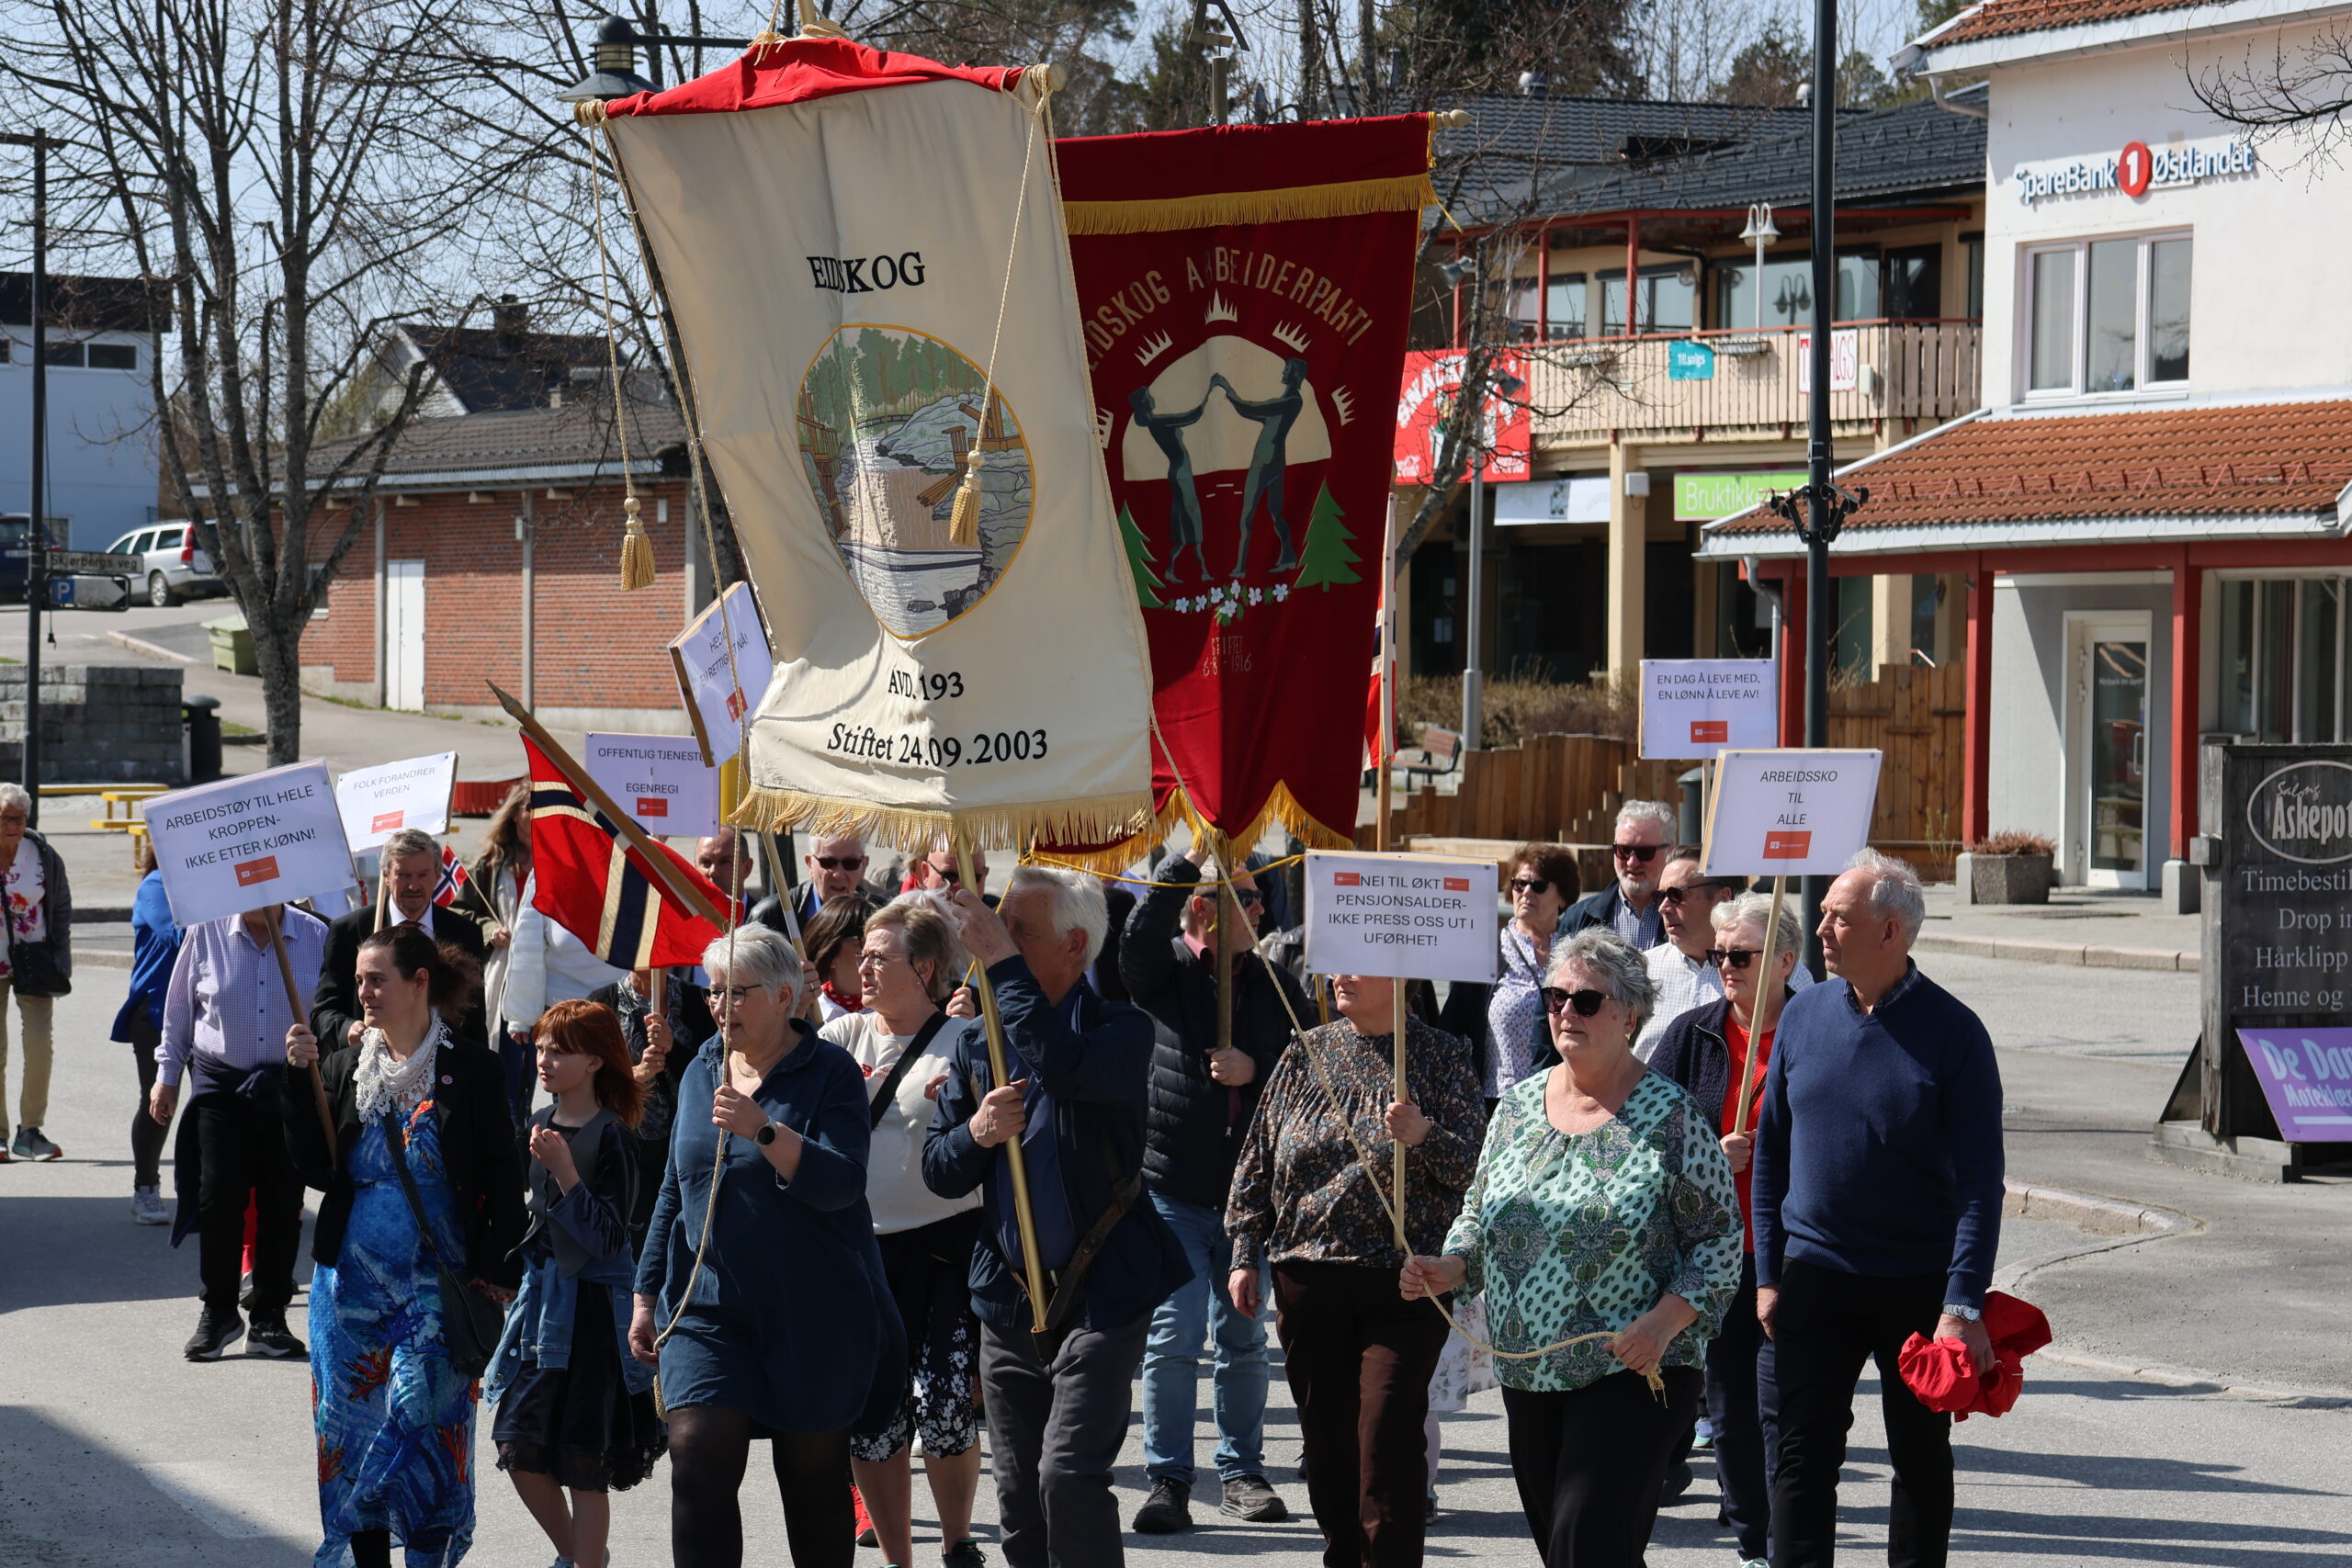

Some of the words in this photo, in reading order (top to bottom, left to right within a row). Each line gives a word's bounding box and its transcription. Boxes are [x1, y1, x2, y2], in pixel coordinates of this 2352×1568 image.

[2014, 158, 2118, 204] SpareBank
[2126, 151, 2139, 187] 1
[2152, 142, 2254, 183] Østlandet
[806, 252, 925, 294] EIDSKOG
[1087, 270, 1171, 371] IDSKOG
[57, 581, 70, 601] P
[920, 671, 965, 701] 193
[1657, 674, 1671, 684] EN
[1674, 674, 1696, 684] DAG
[1698, 671, 1705, 684] Å
[1707, 673, 1732, 684] LEVE
[1734, 673, 1760, 684] MED,
[1658, 690, 1672, 700] EN
[1675, 690, 1705, 700] LØNN
[1707, 687, 1714, 699] Å
[1716, 690, 1741, 699] LEVE
[1743, 689, 1759, 699] AV!
[598, 748, 655, 760] OFFENTLIG
[827, 722, 893, 761] Stiftet
[899, 728, 1048, 768] 24.09.2003
[354, 778, 378, 791] FOLK
[379, 766, 435, 785] FORANDRER
[1759, 771, 1838, 783] ARBEIDSSKO
[374, 784, 411, 798] VERDEN
[626, 783, 679, 795] EGENREGI
[1788, 793, 1804, 804] TIL
[166, 798, 252, 830] ARBEIDSTØY
[254, 794, 276, 809] TIL
[277, 784, 314, 804] HELE
[209, 814, 281, 840] KROPPEN-
[1776, 814, 1807, 825] ALLE
[185, 852, 217, 870] IKKE
[219, 840, 262, 861] ETTER
[263, 828, 316, 851] KJØNN!
[1360, 875, 1385, 887] NEI
[1388, 876, 1408, 888] TIL
[1411, 877, 1442, 890] ØKT
[1336, 894, 1467, 910] PENSJONSALDER-
[1329, 913, 1360, 925] IKKE
[1363, 914, 1410, 927] PRESS
[1414, 916, 1444, 928] OSS
[1448, 918, 1467, 929] UT
[2278, 908, 2332, 935] Drop
[1363, 932, 1438, 946] UFØRHET!
[2255, 945, 2348, 974] Hårklipp
[2242, 985, 2311, 1008] Henne
[2317, 989, 2343, 1011] og
[2258, 1038, 2307, 1081] De
